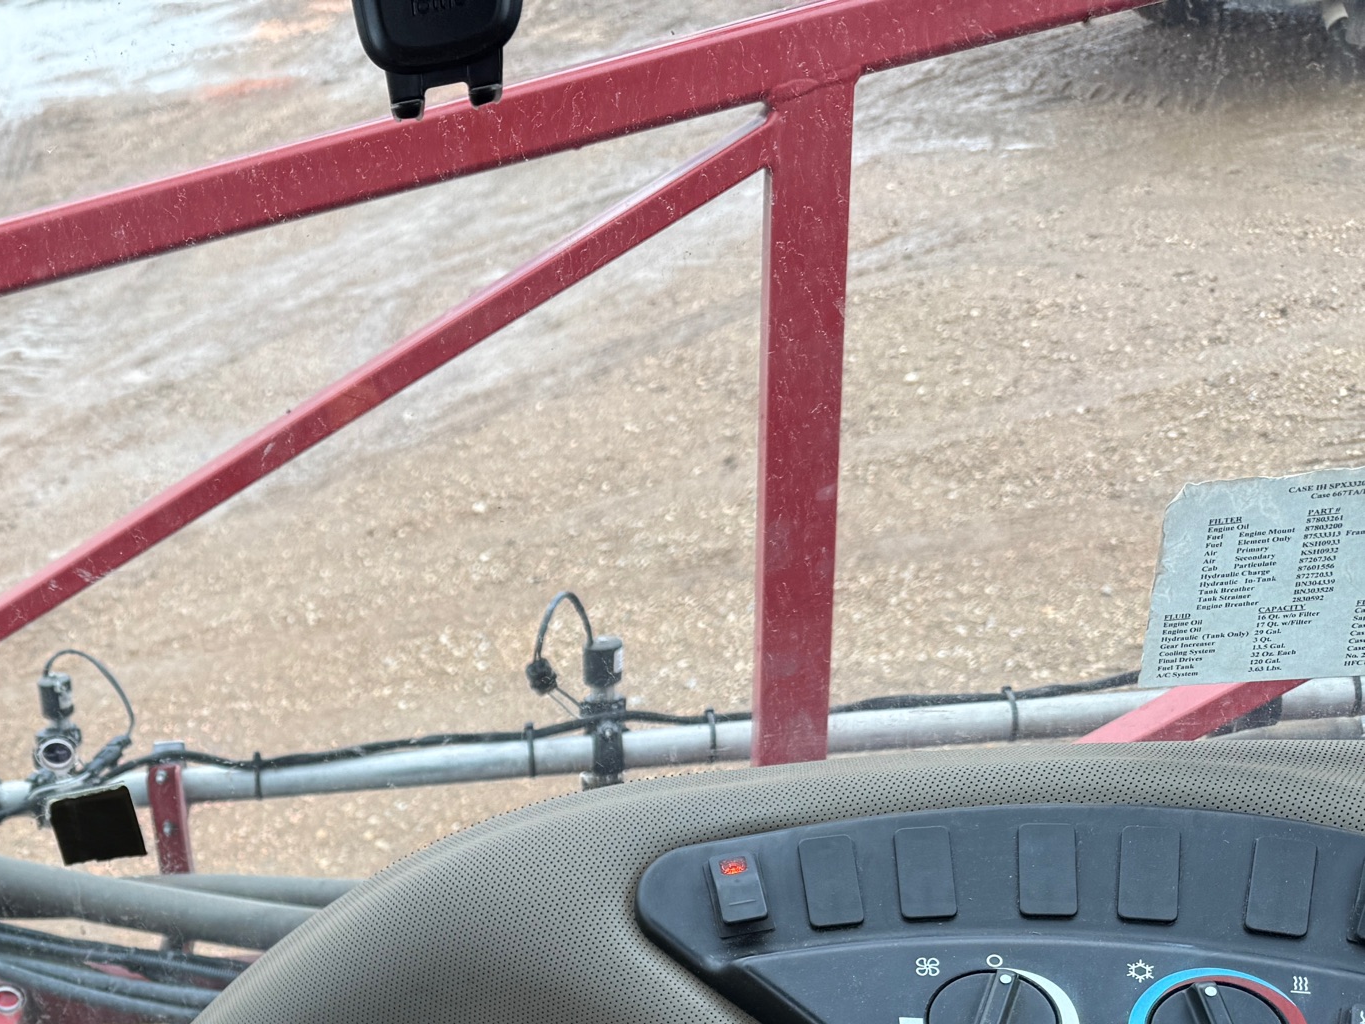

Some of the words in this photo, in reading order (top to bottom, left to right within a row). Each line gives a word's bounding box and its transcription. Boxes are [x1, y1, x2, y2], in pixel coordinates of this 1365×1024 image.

[1288, 485, 1314, 494] CASE
[1307, 507, 1334, 516] PART
[1208, 516, 1242, 526] FILTER
[1238, 530, 1267, 538] Engine
[1268, 527, 1296, 535] Mount
[1237, 538, 1270, 546] Element
[1272, 535, 1292, 543] Only
[1236, 546, 1269, 554] Primary
[1235, 553, 1276, 562] Secondary
[1234, 561, 1277, 570] Particulate
[1200, 571, 1239, 580] Hydraulic
[1241, 569, 1271, 577] Charge
[1199, 579, 1238, 588] Hydraulic
[1220, 586, 1255, 594] Breather
[1198, 595, 1217, 603] Tank
[1196, 603, 1223, 611] Engine
[1224, 600, 1259, 608] Breather
[1258, 604, 1306, 614] CAPACITY
[1164, 613, 1191, 621] FLUID
[1162, 628, 1188, 636] Engine
[1161, 635, 1198, 643] Hydraulic
[1201, 633, 1225, 641] (Tank
[1180, 641, 1216, 649] Increaser
[1189, 648, 1216, 656] System
[1172, 671, 1198, 679] System
